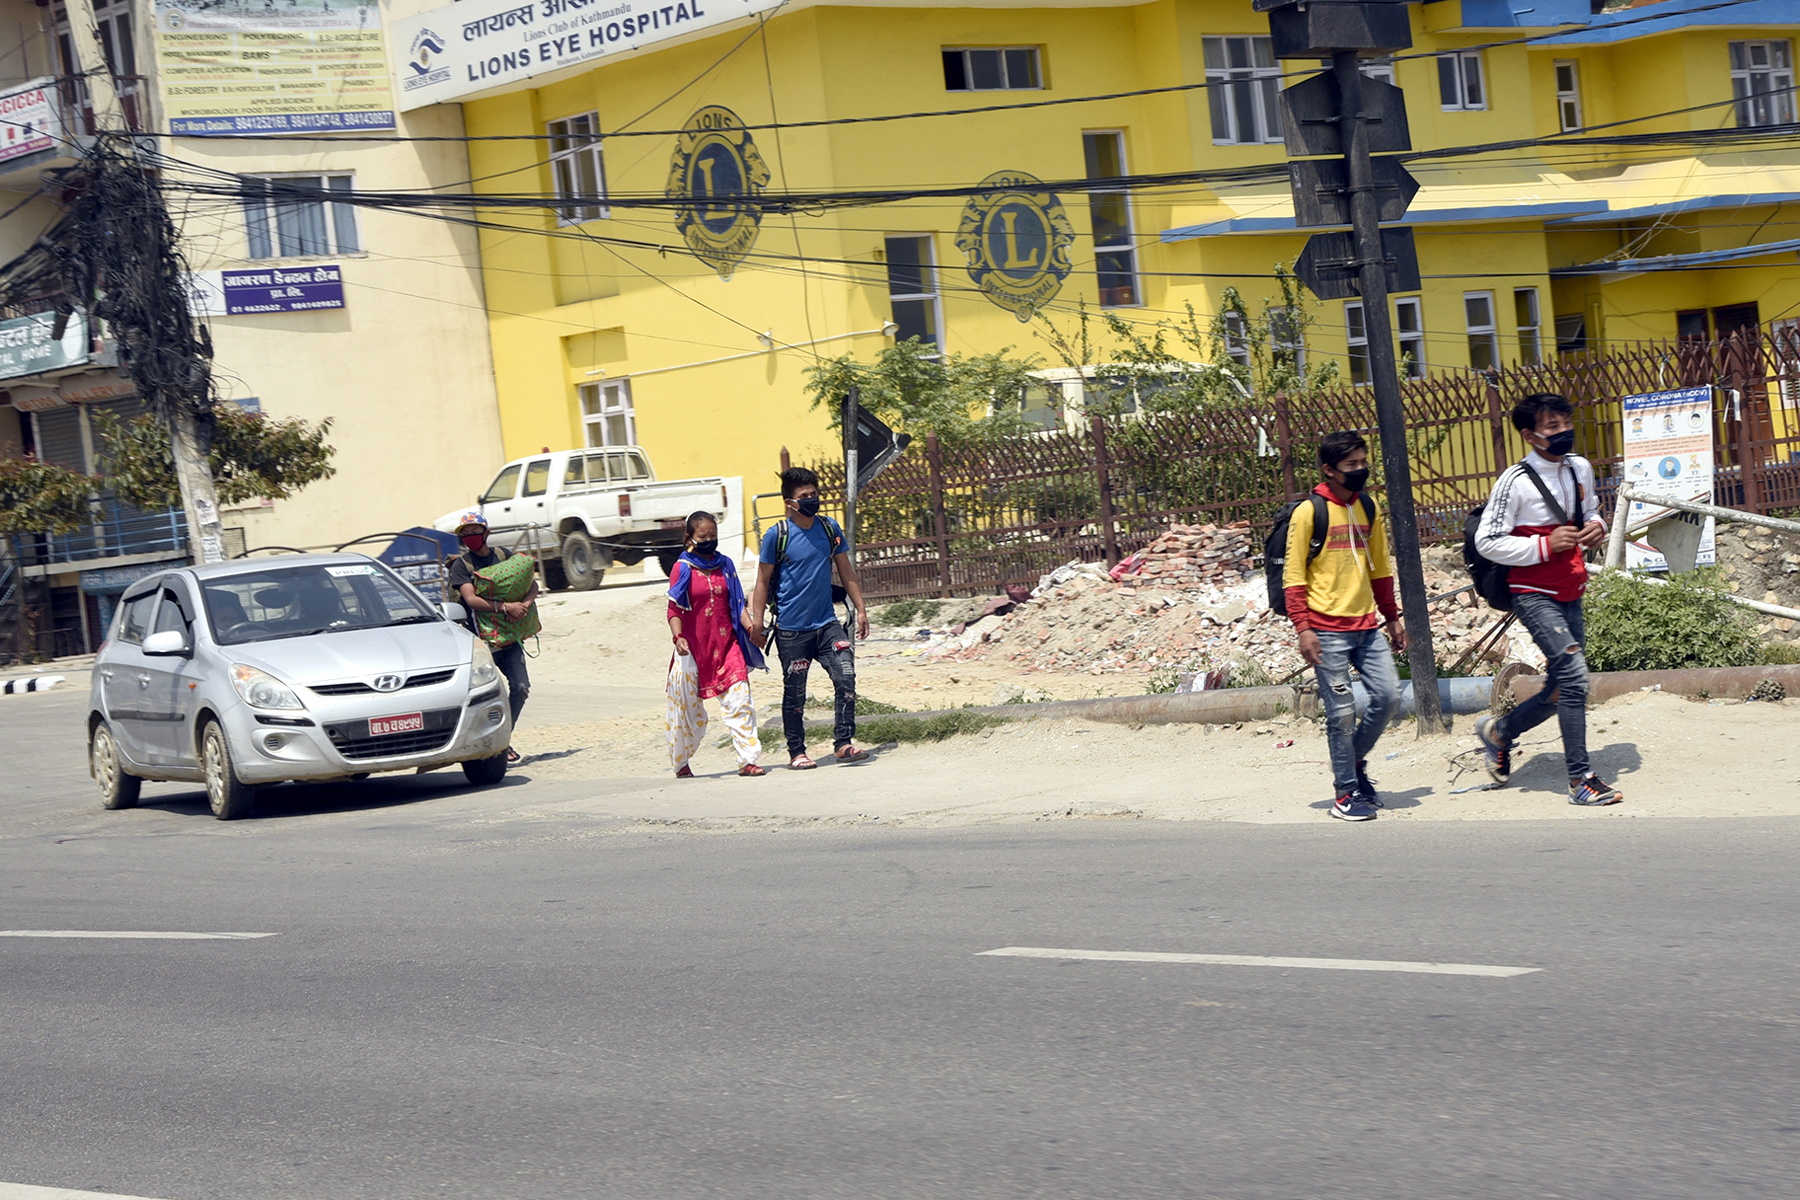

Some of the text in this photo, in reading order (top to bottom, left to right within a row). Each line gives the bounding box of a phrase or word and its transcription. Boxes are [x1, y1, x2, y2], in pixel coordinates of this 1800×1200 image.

[462, 4, 535, 41] लायन्स
[523, 3, 632, 43] Lions Club of Kathmandu
[163, 33, 228, 41] ENGINEERING
[335, 33, 379, 41] AGRICULTURE
[467, 0, 705, 81] LIONS EYE HOSPITAL
[243, 51, 270, 60] BAMS
[166, 66, 252, 75] COMPUTER APPLICATION
[404, 78, 418, 90] LIONS
[418, 75, 428, 86] EYE
[429, 69, 451, 82] HOSPITAL
[184, 86, 219, 95] FORESTRY
[235, 85, 276, 93] HORTICULTURE
[172, 121, 186, 132] For
[186, 121, 205, 131] More
[205, 120, 235, 131] Details:
[687, 113, 732, 142] LIONS
[698, 158, 736, 220] L
[690, 226, 753, 259] INTERNATIONAL
[1001, 212, 1038, 269] L
[224, 268, 339, 287] जागरण डेन्टल होम
[287, 286, 305, 298] लि.
[984, 279, 1054, 304] INTERNATIONAL
[21, 344, 52, 361] HOME
[62, 385, 116, 402] GALLERY
[1626, 396, 1650, 405] NOVEL
[1651, 392, 1682, 402] CORONA
